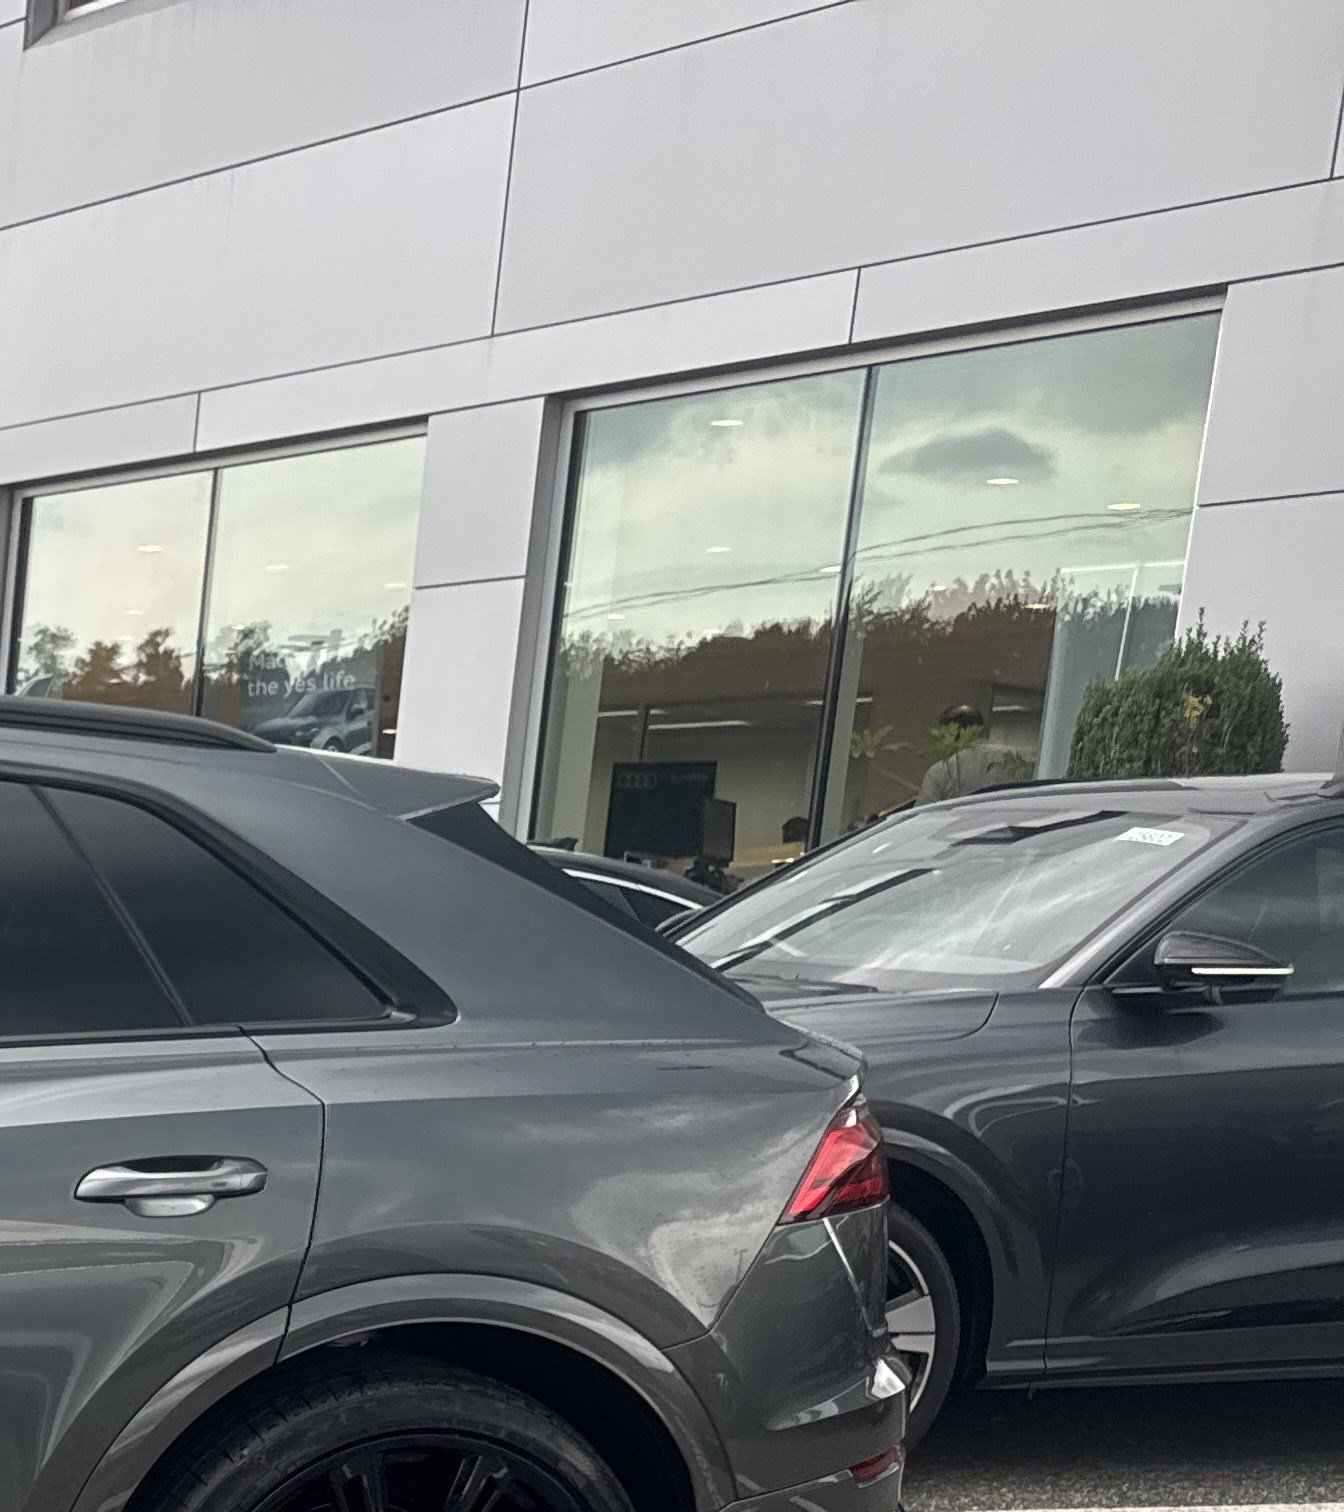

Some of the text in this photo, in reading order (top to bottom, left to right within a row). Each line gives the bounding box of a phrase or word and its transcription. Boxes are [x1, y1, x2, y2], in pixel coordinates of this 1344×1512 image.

[248, 671, 355, 699] the yes life
